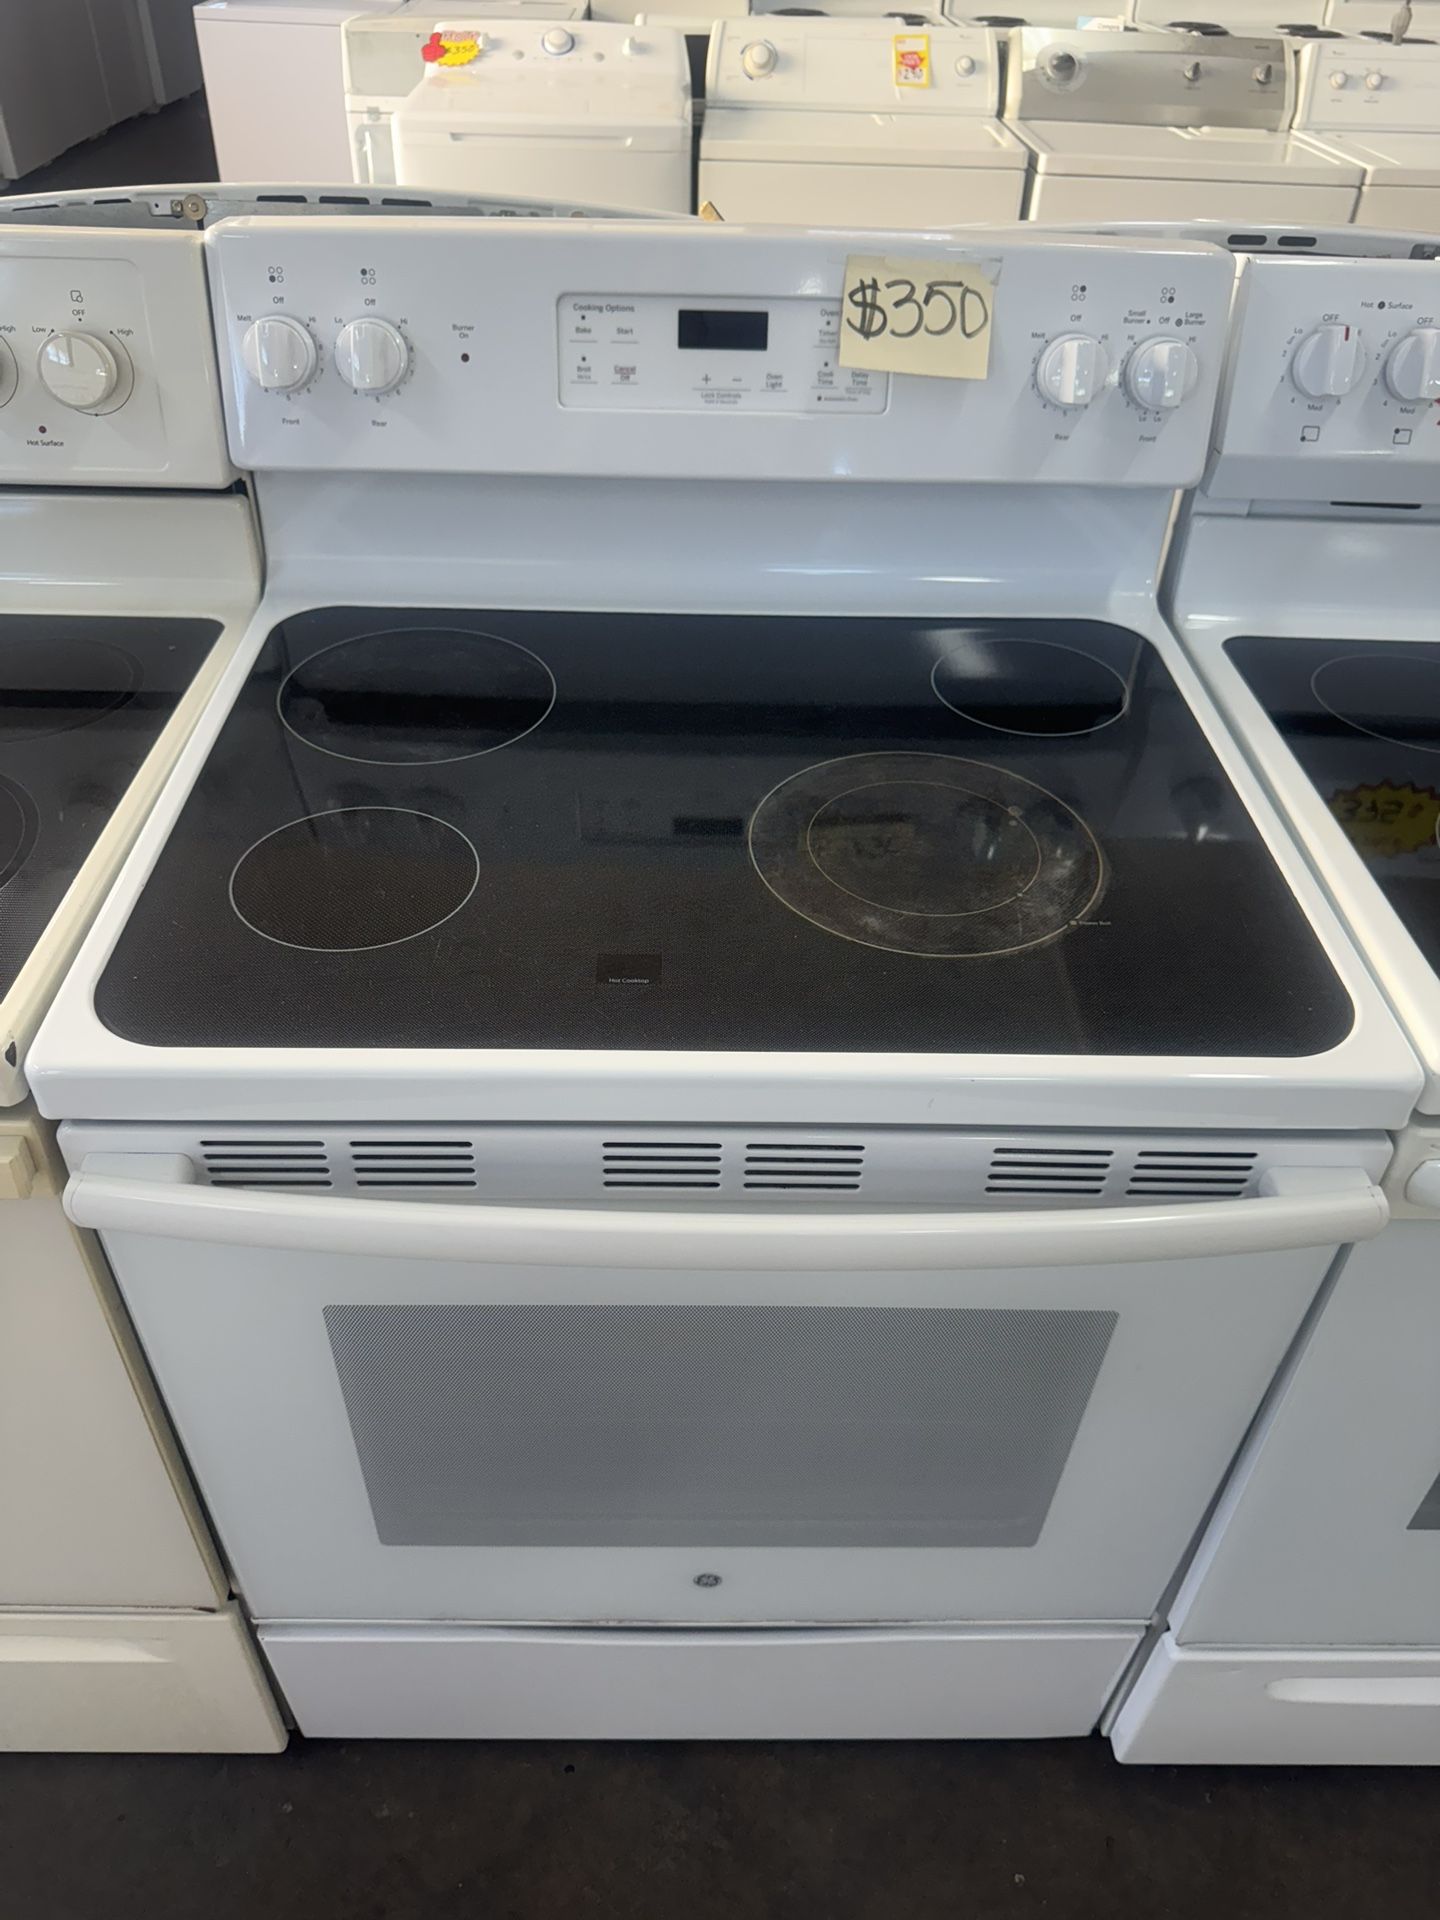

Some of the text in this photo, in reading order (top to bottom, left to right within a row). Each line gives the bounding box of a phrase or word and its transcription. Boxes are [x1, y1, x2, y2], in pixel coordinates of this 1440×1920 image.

[272, 296, 285, 304] Off
[364, 298, 376, 306] Off
[572, 303, 635, 313] Cooking Options
[846, 277, 989, 340] $350
[1387, 302, 1413, 310] Surface
[237, 314, 252, 322] Melt
[1069, 314, 1082, 322] Off
[1185, 312, 1203, 320] Large
[1322, 313, 1340, 322] OFF
[1123, 317, 1145, 325] Burner
[1158, 316, 1170, 325] Off
[1417, 316, 1434, 325] OFF
[452, 323, 474, 332] Burner
[616, 327, 633, 335] Start
[117, 328, 133, 337] High
[281, 418, 300, 426] Front
[1138, 434, 1157, 442] Front
[40, 440, 64, 448] Surface
